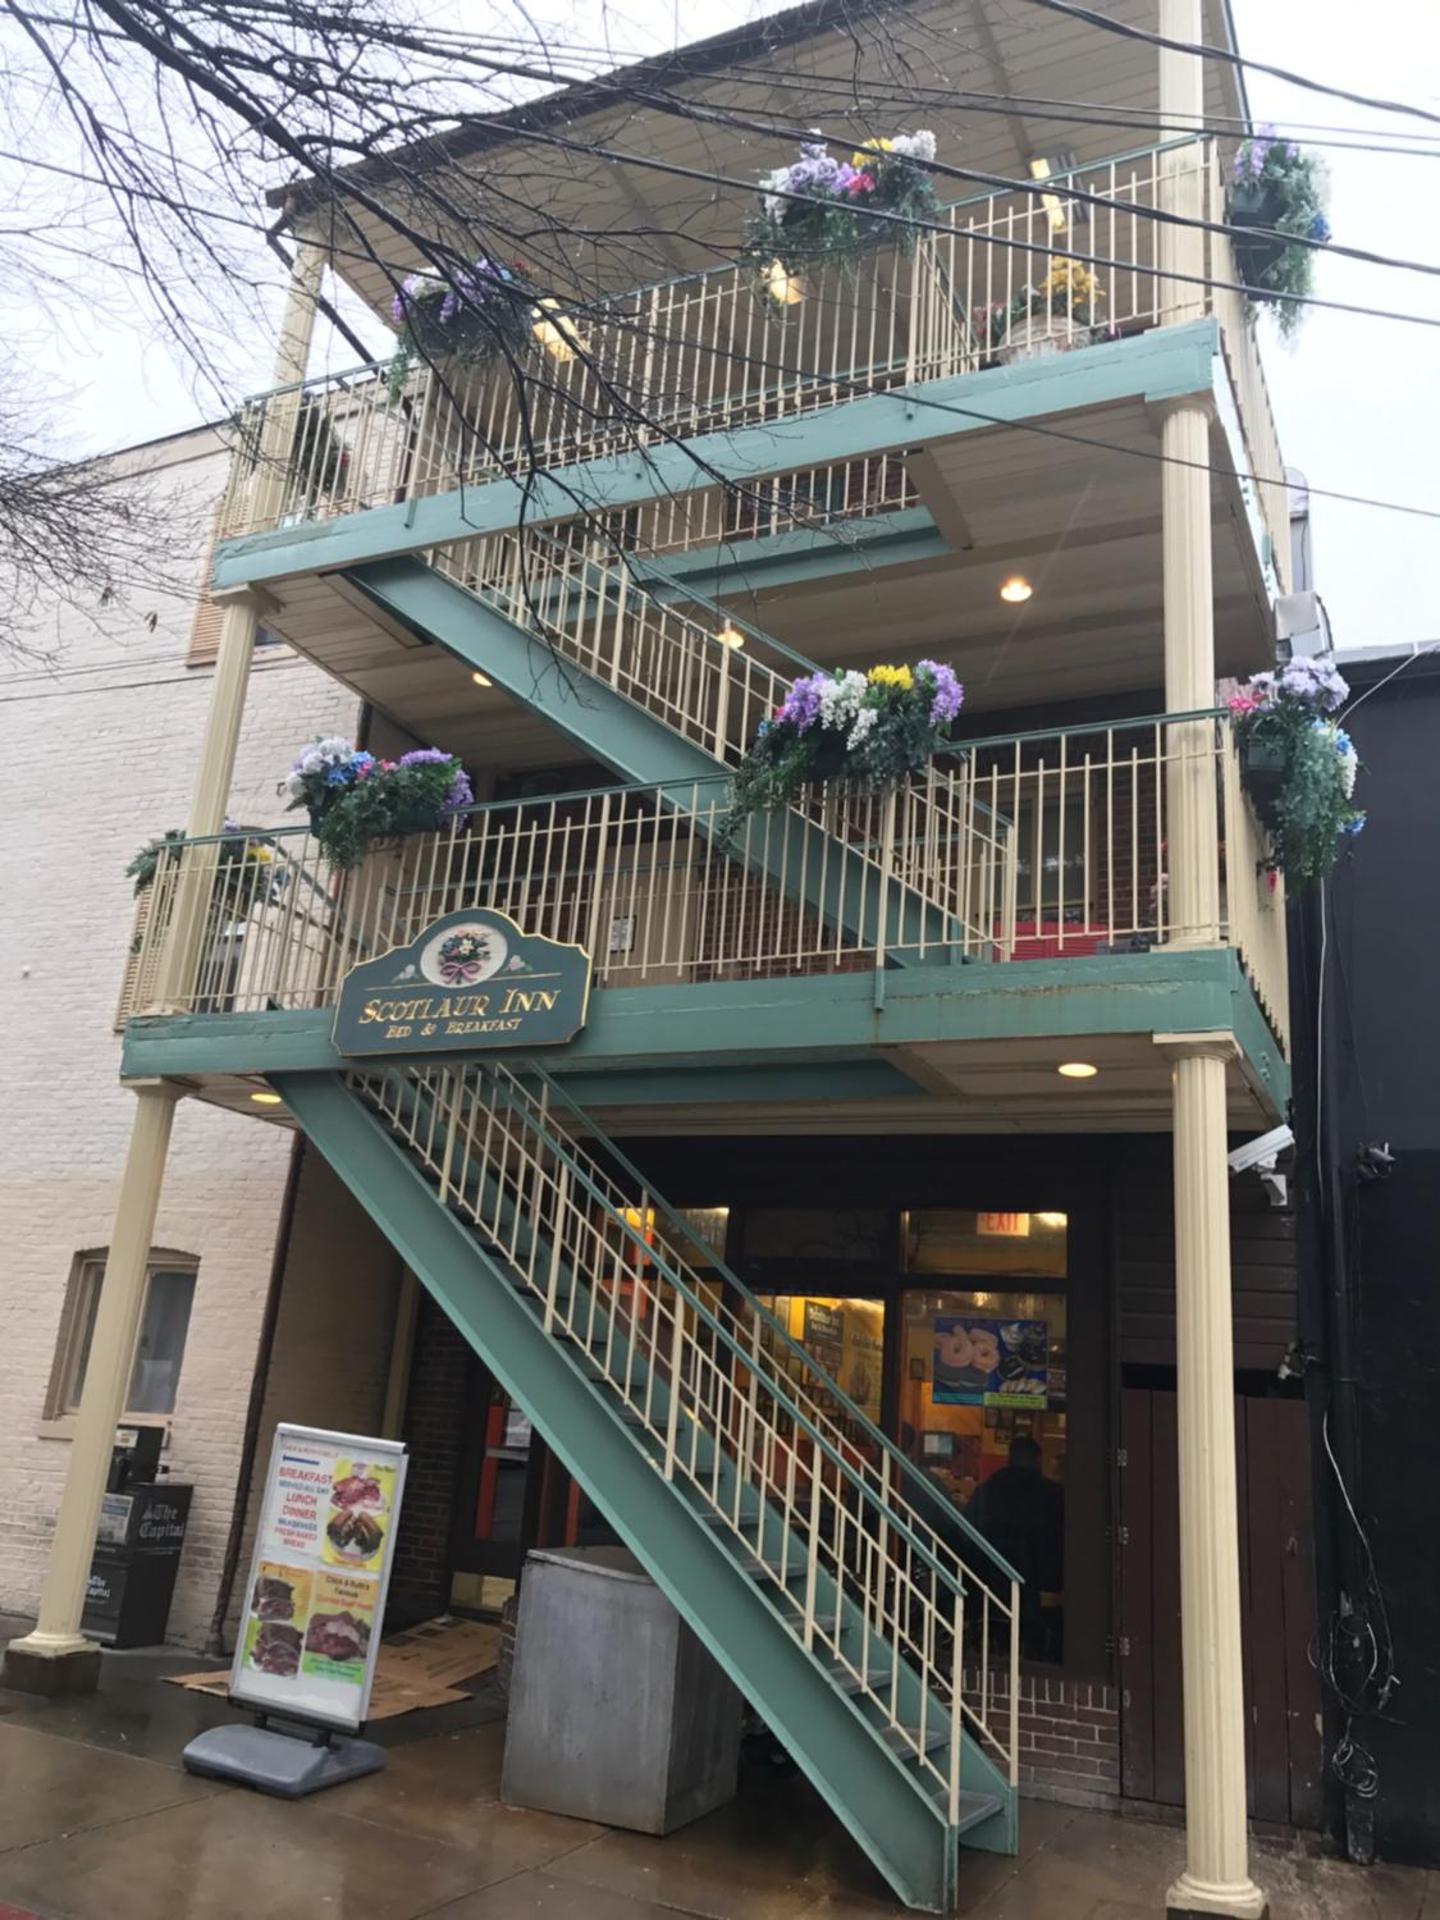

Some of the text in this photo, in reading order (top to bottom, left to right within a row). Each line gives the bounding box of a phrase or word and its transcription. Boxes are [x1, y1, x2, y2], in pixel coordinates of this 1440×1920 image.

[358, 987, 561, 1024] SCOTLAUR INN
[385, 1018, 523, 1039] BED & BREAKFAST
[985, 1213, 1018, 1233] EXIT
[279, 1466, 333, 1485] BREAKFAST
[286, 1491, 318, 1506] LUNCH
[154, 1504, 178, 1520] The
[282, 1504, 318, 1521] DINNER
[139, 1521, 185, 1540] Capital
